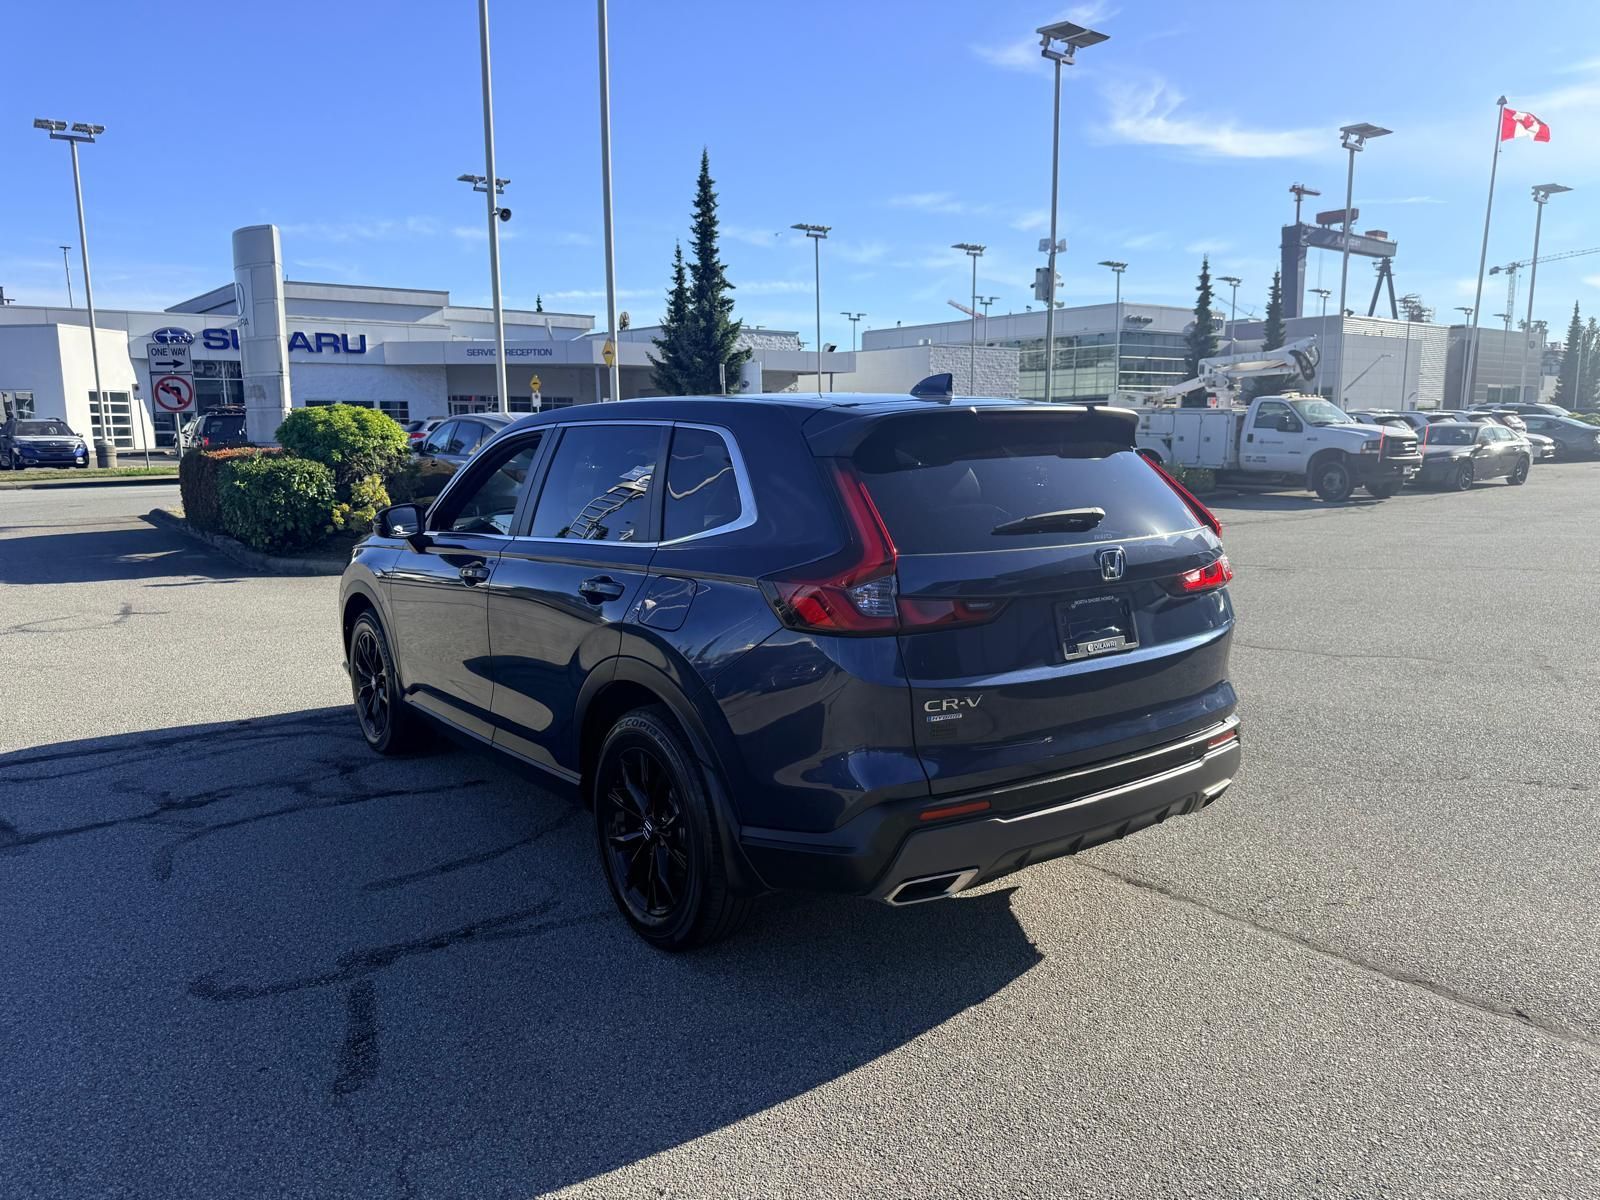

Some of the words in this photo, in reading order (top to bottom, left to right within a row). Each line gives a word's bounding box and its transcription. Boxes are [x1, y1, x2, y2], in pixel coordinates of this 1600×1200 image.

[151, 348, 168, 356] ONE
[170, 347, 186, 356] WAY
[466, 348, 496, 356] SERVIC
[505, 348, 552, 356] RECEPTION
[924, 695, 983, 712] CR-V
